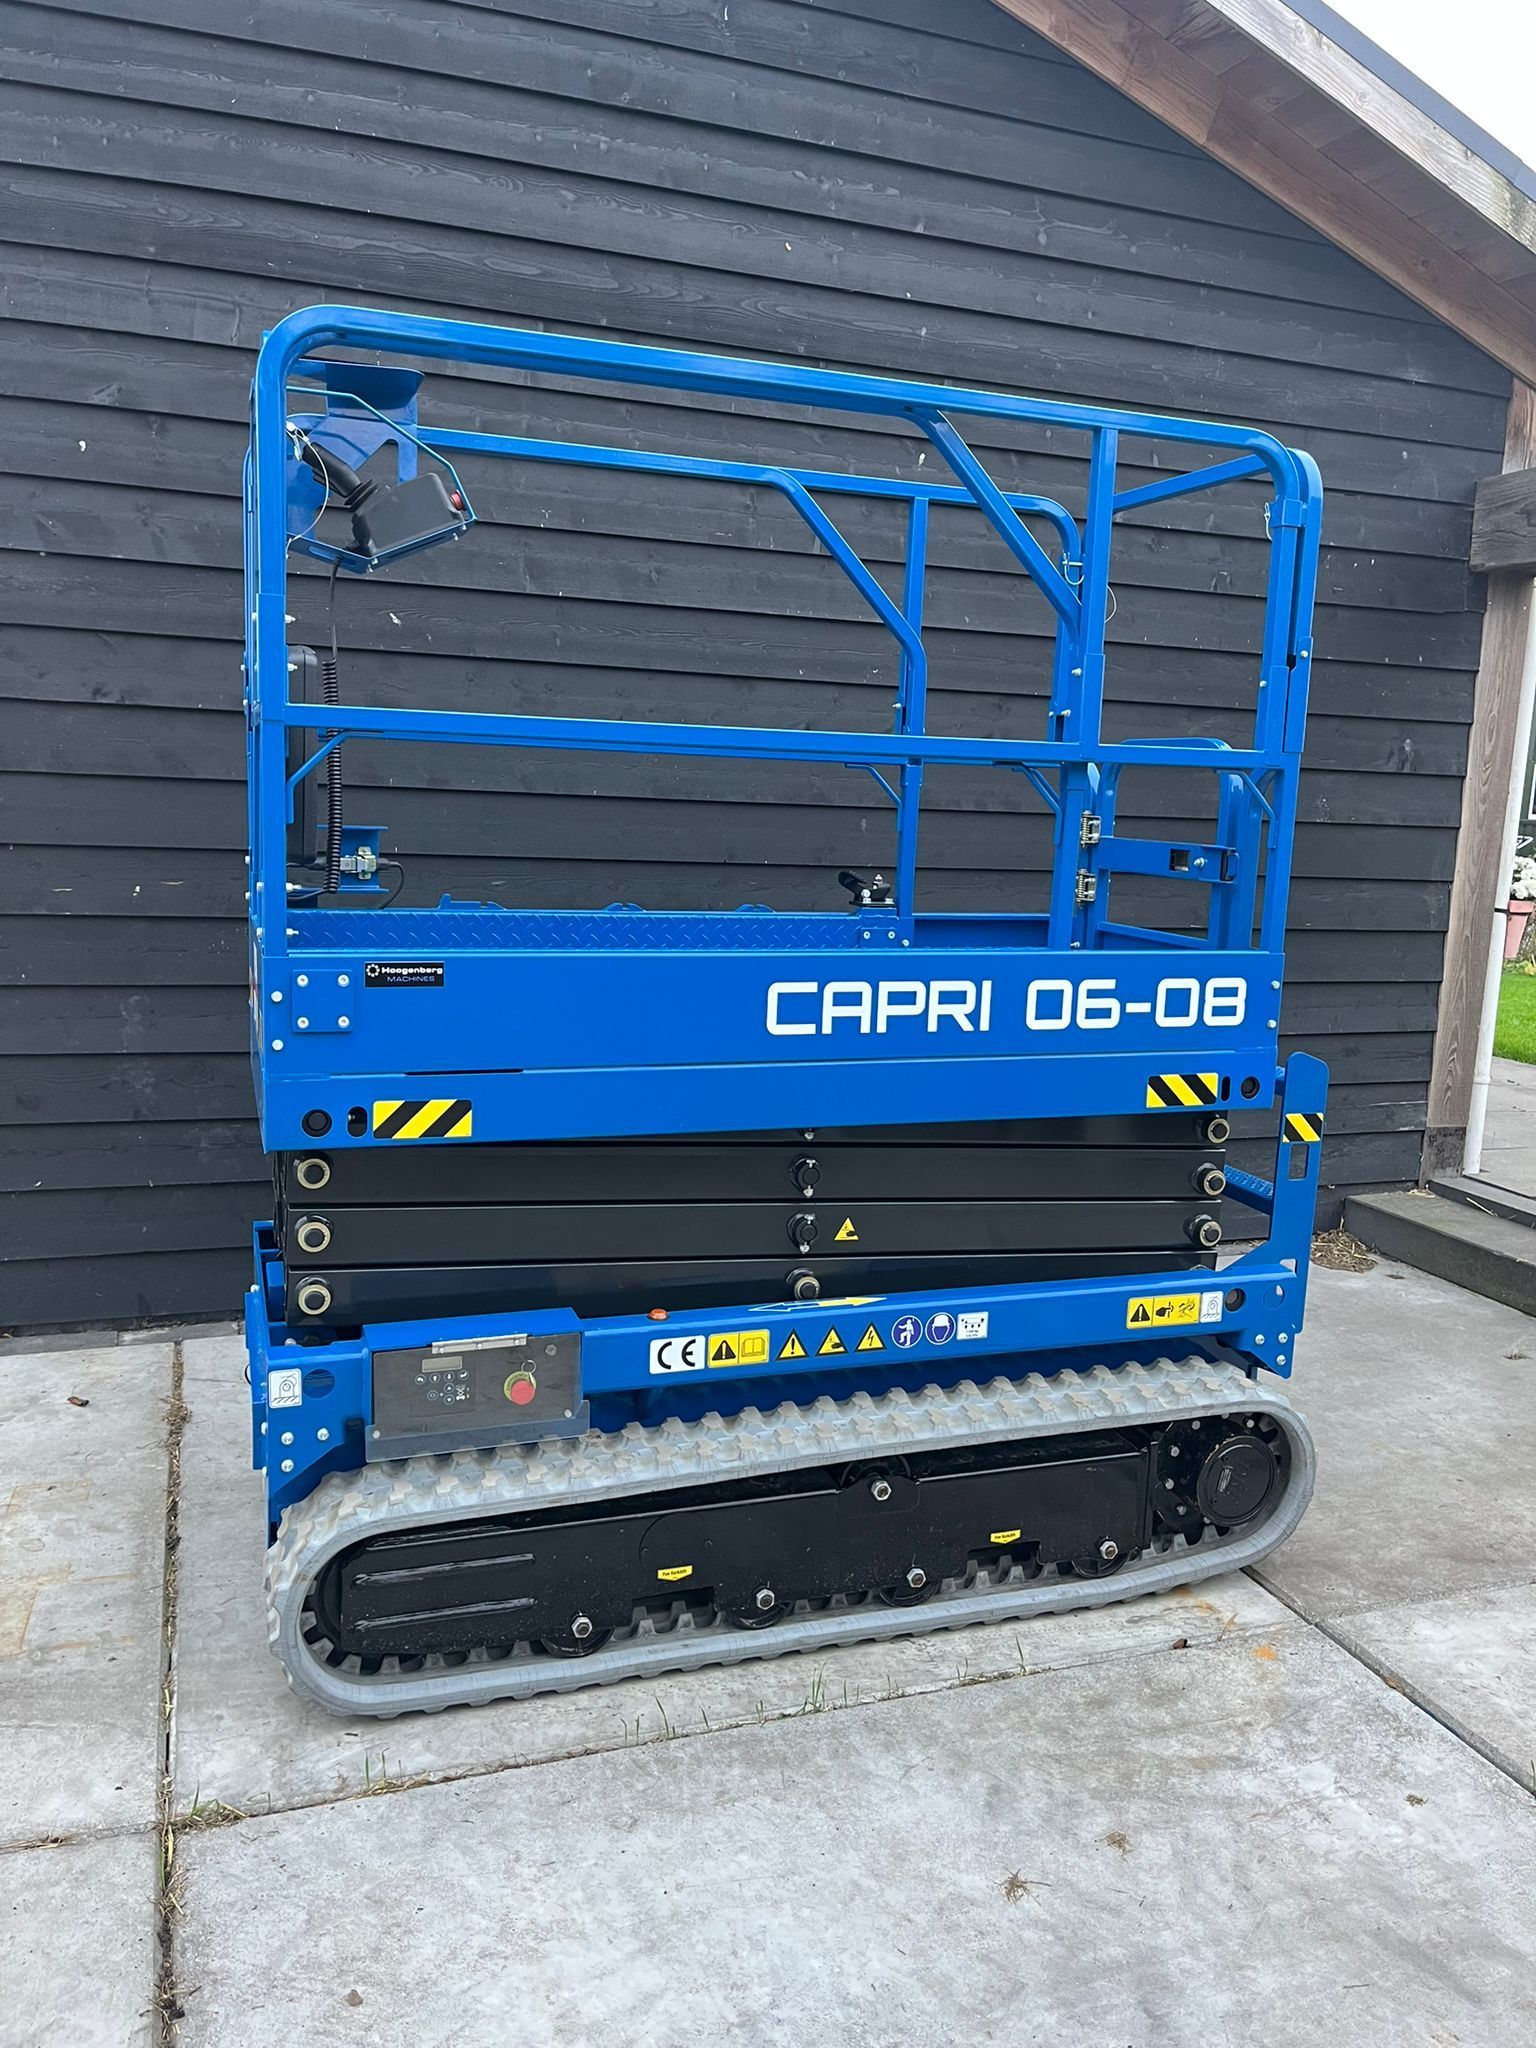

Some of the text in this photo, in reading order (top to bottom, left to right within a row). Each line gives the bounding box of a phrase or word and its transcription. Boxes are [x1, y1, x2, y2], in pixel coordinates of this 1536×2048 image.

[381, 966, 443, 975] Hoogenberg
[387, 975, 436, 983] MACHINES
[766, 976, 1248, 1036] CAPRI 06-08
[657, 1338, 697, 1370] CE
